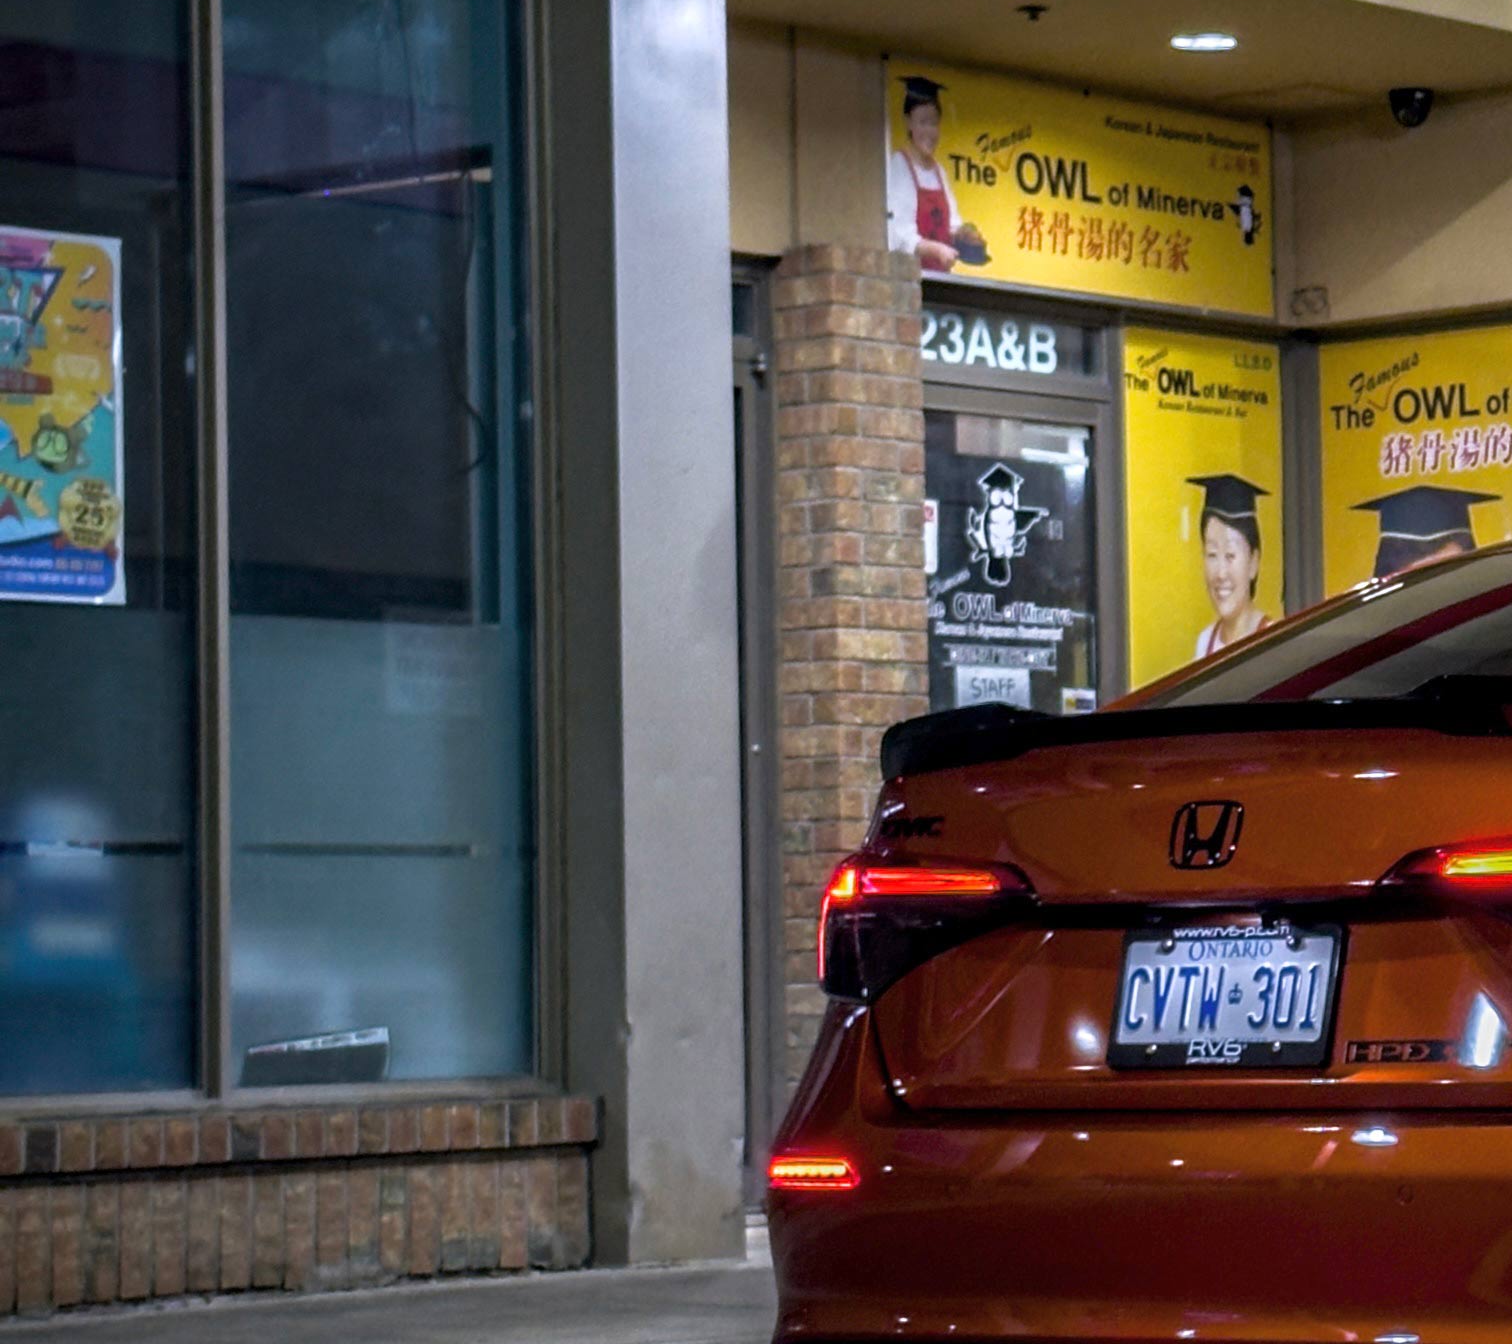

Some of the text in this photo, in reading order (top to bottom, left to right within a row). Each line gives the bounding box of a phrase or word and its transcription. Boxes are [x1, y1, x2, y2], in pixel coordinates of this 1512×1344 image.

[975, 125, 1031, 156] Famous
[949, 152, 1225, 222] The OWL of Minerva
[920, 309, 1058, 375] 23A&B
[1125, 367, 1268, 405] The OWL of Minerva
[1349, 352, 1419, 403] Famous
[1330, 404, 1375, 430] The
[1393, 383, 1480, 424] OWL
[1486, 387, 1511, 415] of
[953, 592, 1002, 621] OWL
[970, 676, 1016, 700] STAFF
[1188, 940, 1274, 962] ONTARIO
[1124, 961, 1322, 1033] CVTW 301
[1187, 1038, 1243, 1057] RV6
[1350, 1043, 1431, 1062] HPD
